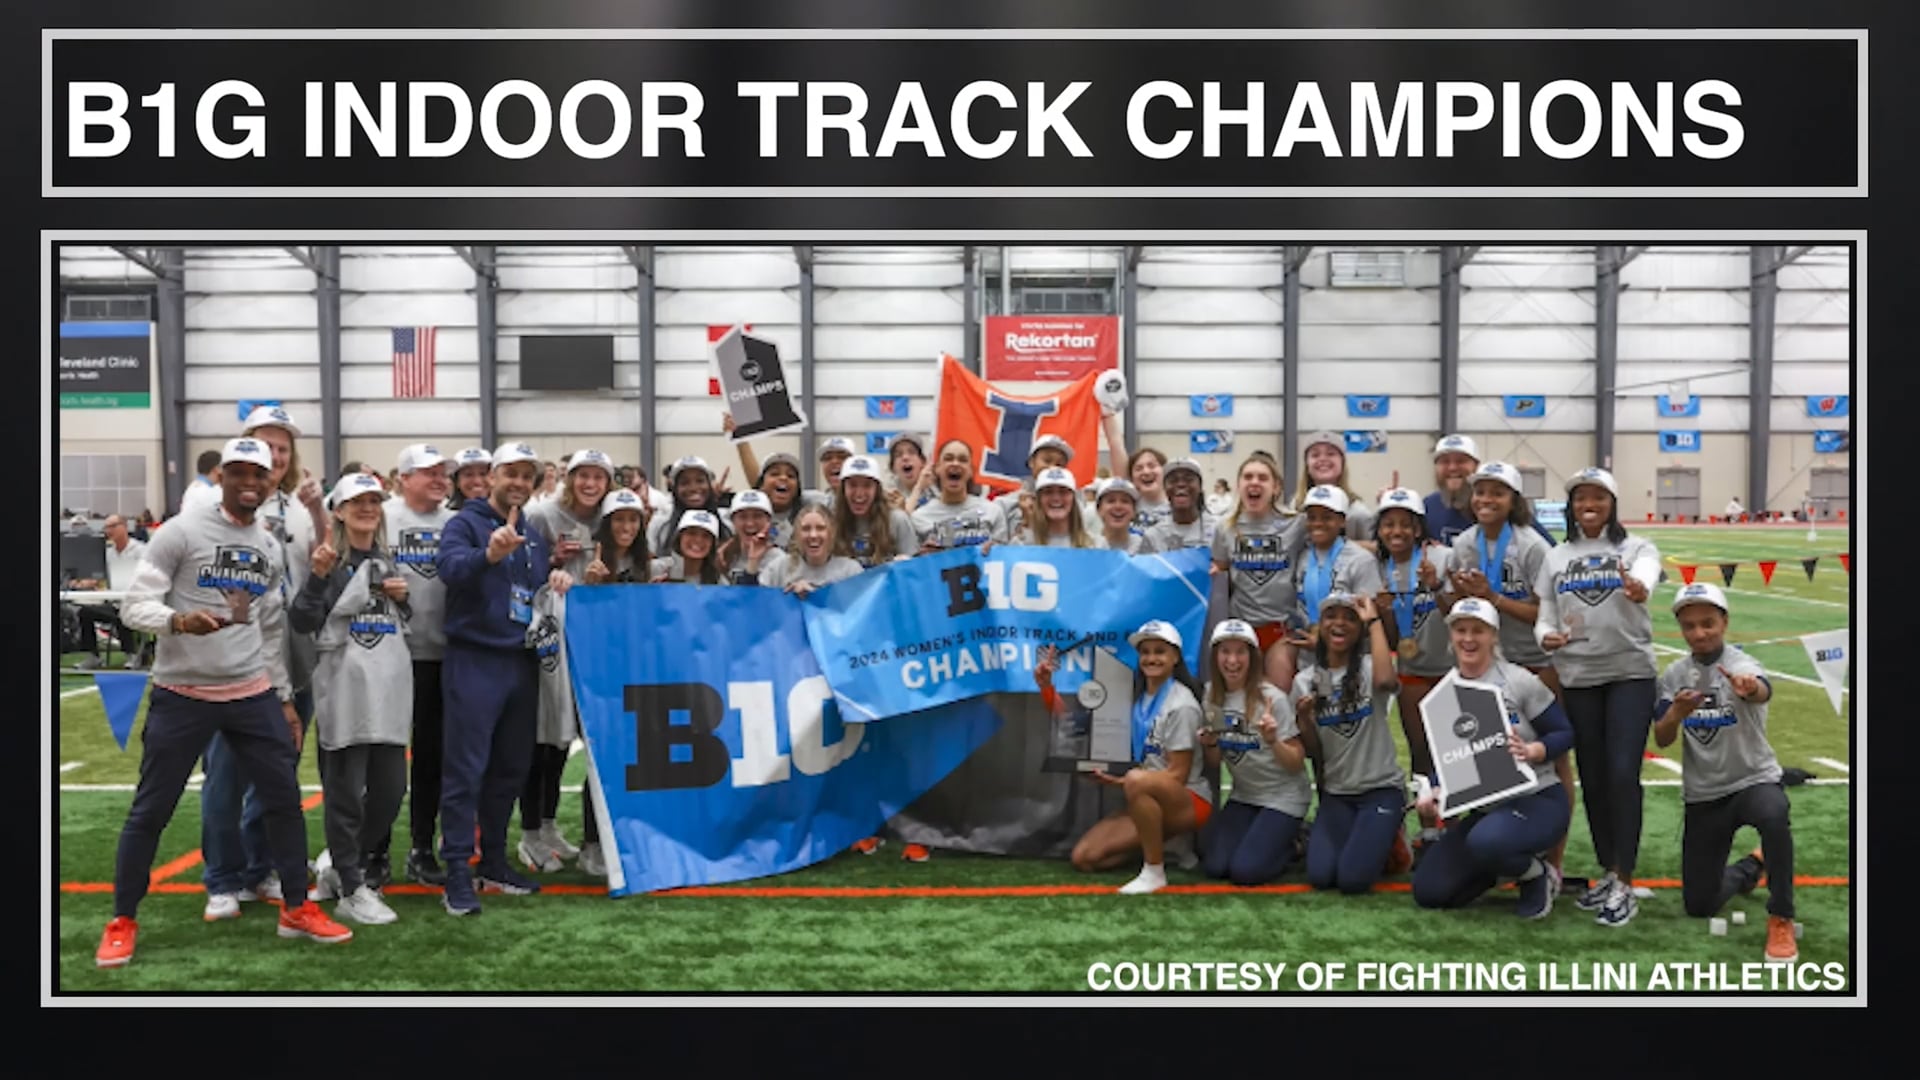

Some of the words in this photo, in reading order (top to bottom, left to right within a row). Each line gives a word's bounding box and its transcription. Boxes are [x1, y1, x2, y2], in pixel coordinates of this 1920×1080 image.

[1005, 332, 1097, 353] Rekortan
[108, 356, 139, 368] Clinic
[730, 380, 785, 402] CHAMPS
[941, 561, 1060, 618] B1G
[849, 650, 889, 669] 2024
[893, 631, 965, 660] WOMEN'S
[1024, 628, 1077, 641] TRACK
[901, 642, 1119, 689] CHAMPIN
[1442, 732, 1505, 765] CHAMPS
